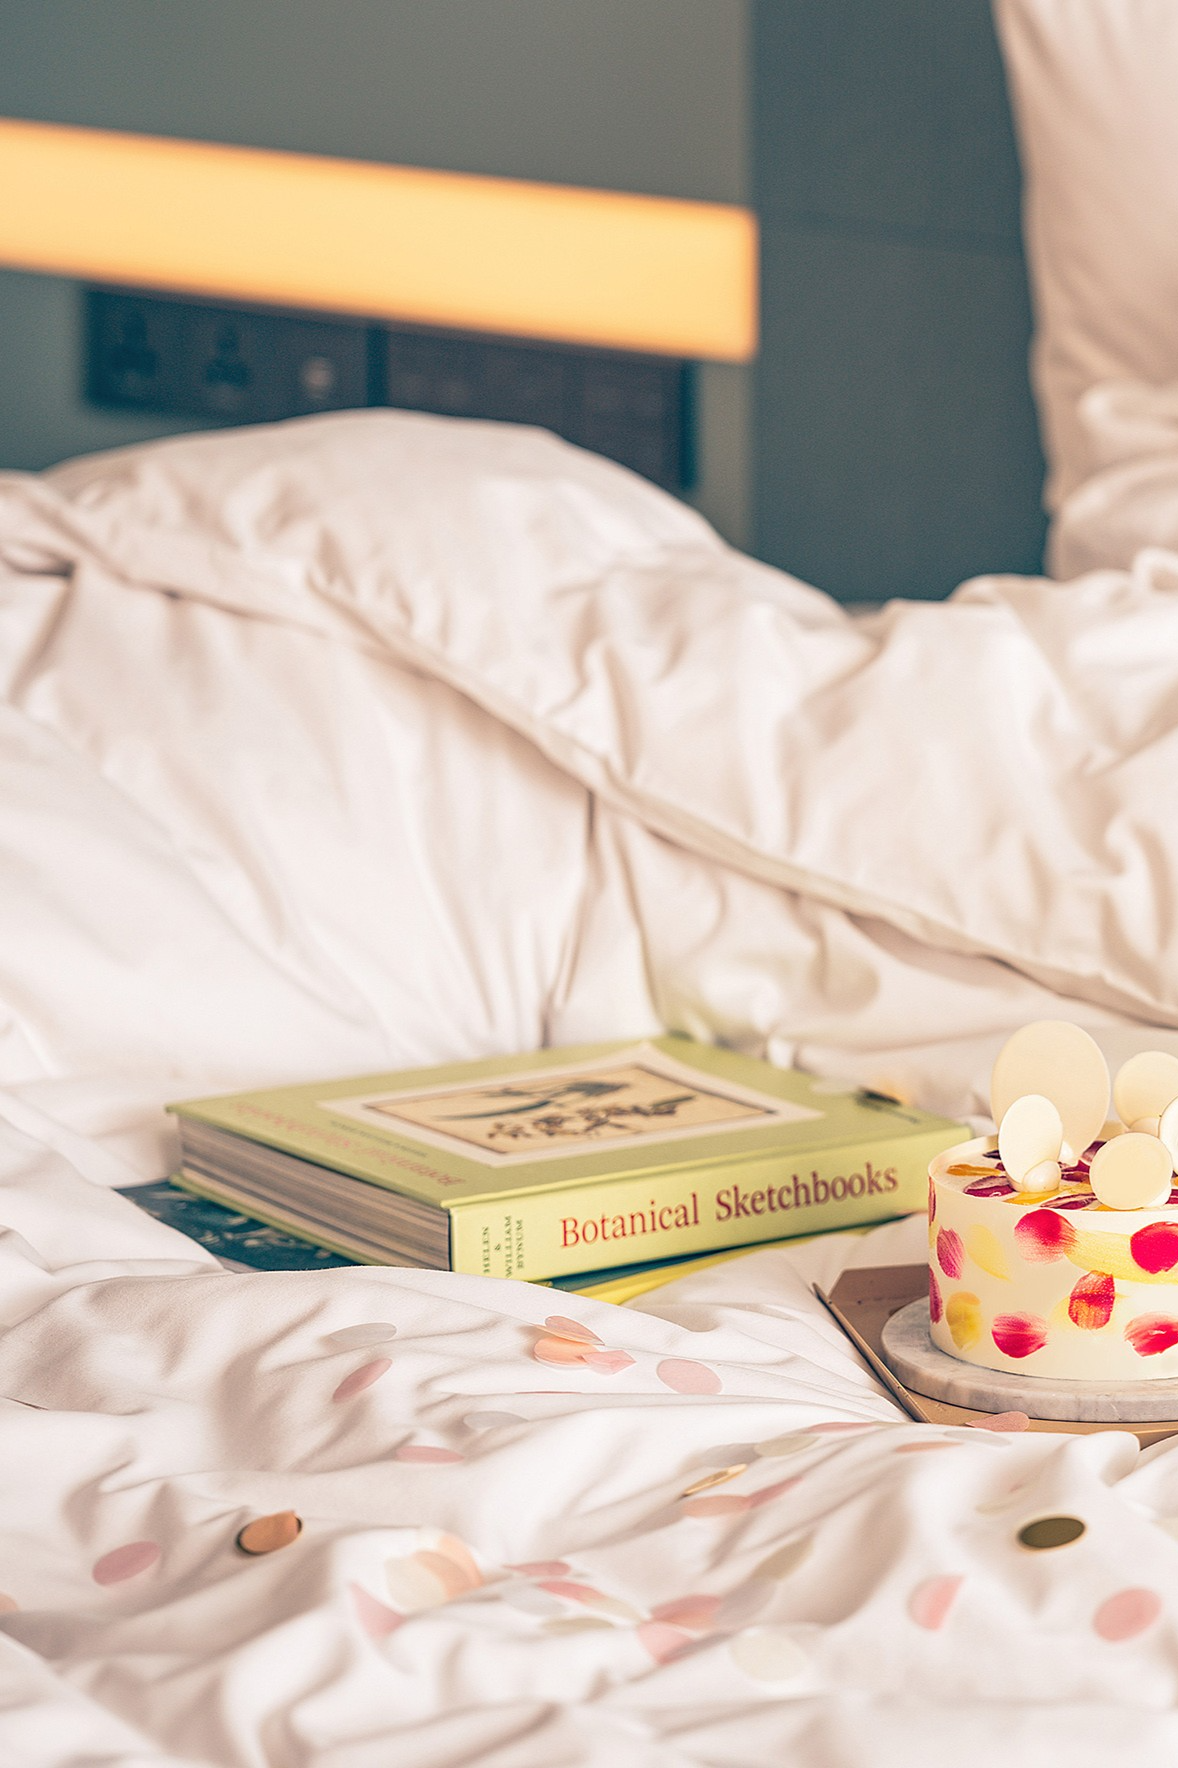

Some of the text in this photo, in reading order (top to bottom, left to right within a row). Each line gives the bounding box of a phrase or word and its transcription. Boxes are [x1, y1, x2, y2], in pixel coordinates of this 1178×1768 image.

[559, 1162, 899, 1248] Botanical Sketchbooks
[482, 1226, 490, 1273] HELEN
